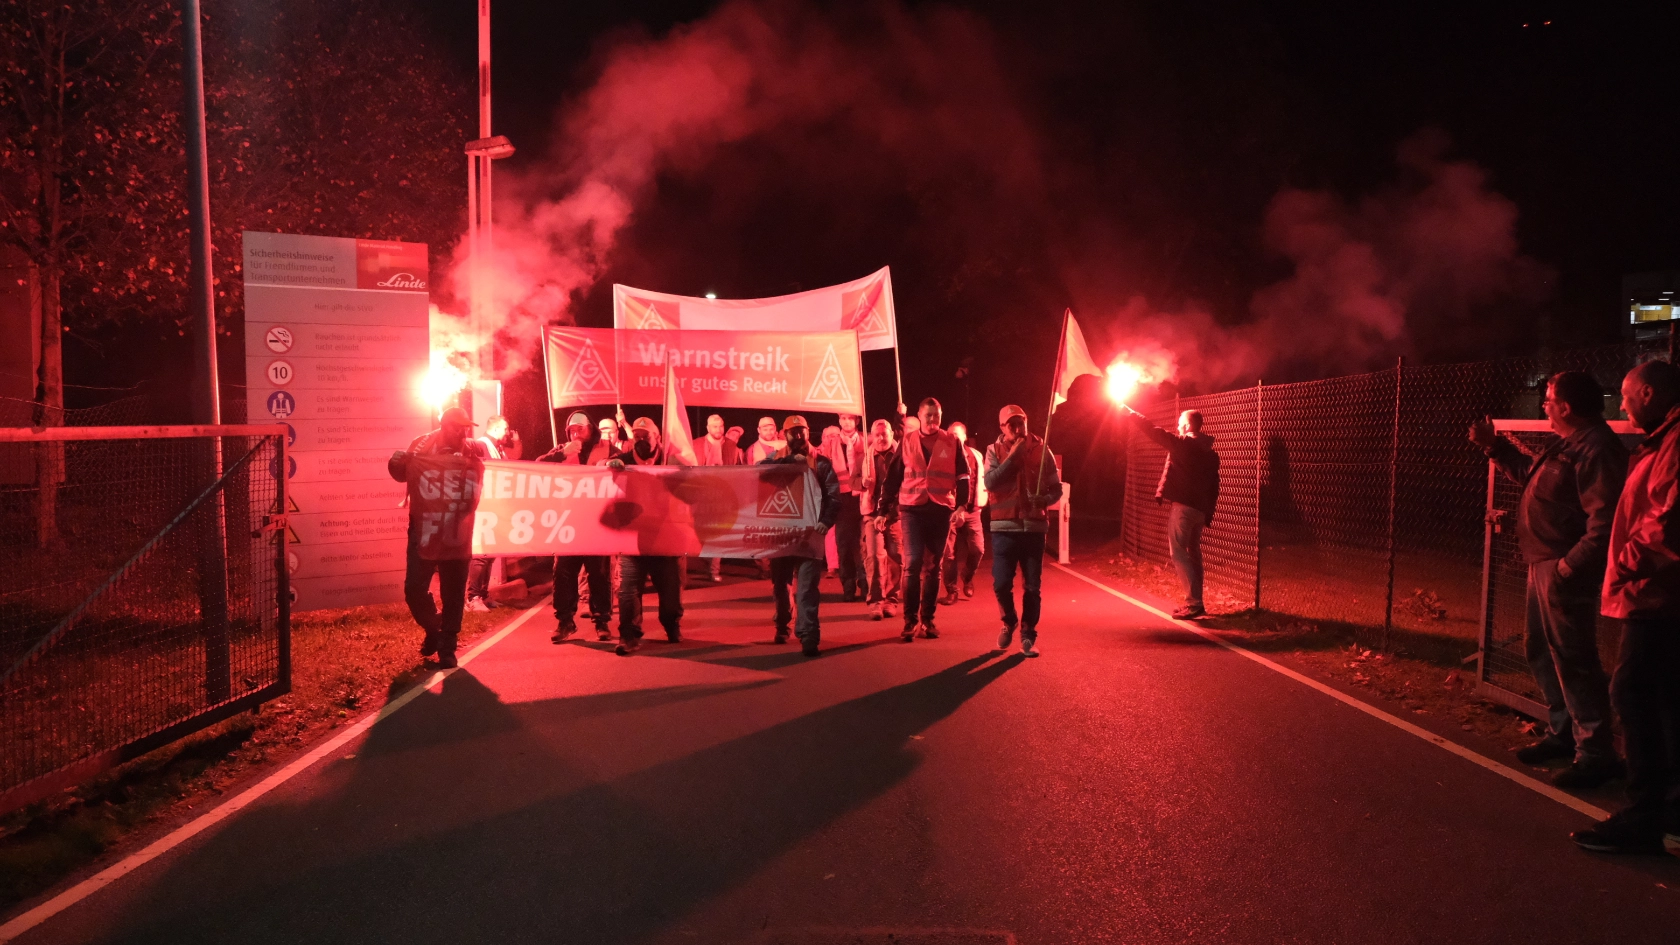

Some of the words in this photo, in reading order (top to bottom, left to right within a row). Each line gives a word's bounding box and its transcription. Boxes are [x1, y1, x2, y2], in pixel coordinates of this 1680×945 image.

[249, 249, 334, 262] Sicherheitshinweise
[250, 261, 262, 270] für
[320, 264, 336, 274] und
[250, 272, 347, 285] Transportunternehmen
[377, 273, 426, 289] Linde
[315, 333, 346, 341] Rauchen
[638, 342, 790, 373] Warnstreik
[273, 366, 288, 379] 10
[691, 377, 738, 393] gutes
[743, 376, 788, 394] Recht
[316, 395, 325, 403] Es
[326, 395, 341, 403] sind
[317, 426, 325, 434] Es
[326, 426, 341, 434] sind
[419, 469, 628, 500] GEMEINSAM
[345, 492, 357, 500] Sie
[358, 491, 369, 500] auf
[320, 519, 350, 528] Achtung:
[352, 517, 376, 527] Gefahr
[377, 516, 396, 525] durch
[420, 502, 499, 548] FÜR
[319, 530, 339, 538] Eisen
[340, 528, 354, 536] und
[355, 527, 376, 536] heiße
[744, 525, 803, 535] SOLIDARITÄT
[320, 555, 338, 563] Bitte
[339, 553, 359, 562] Motor
